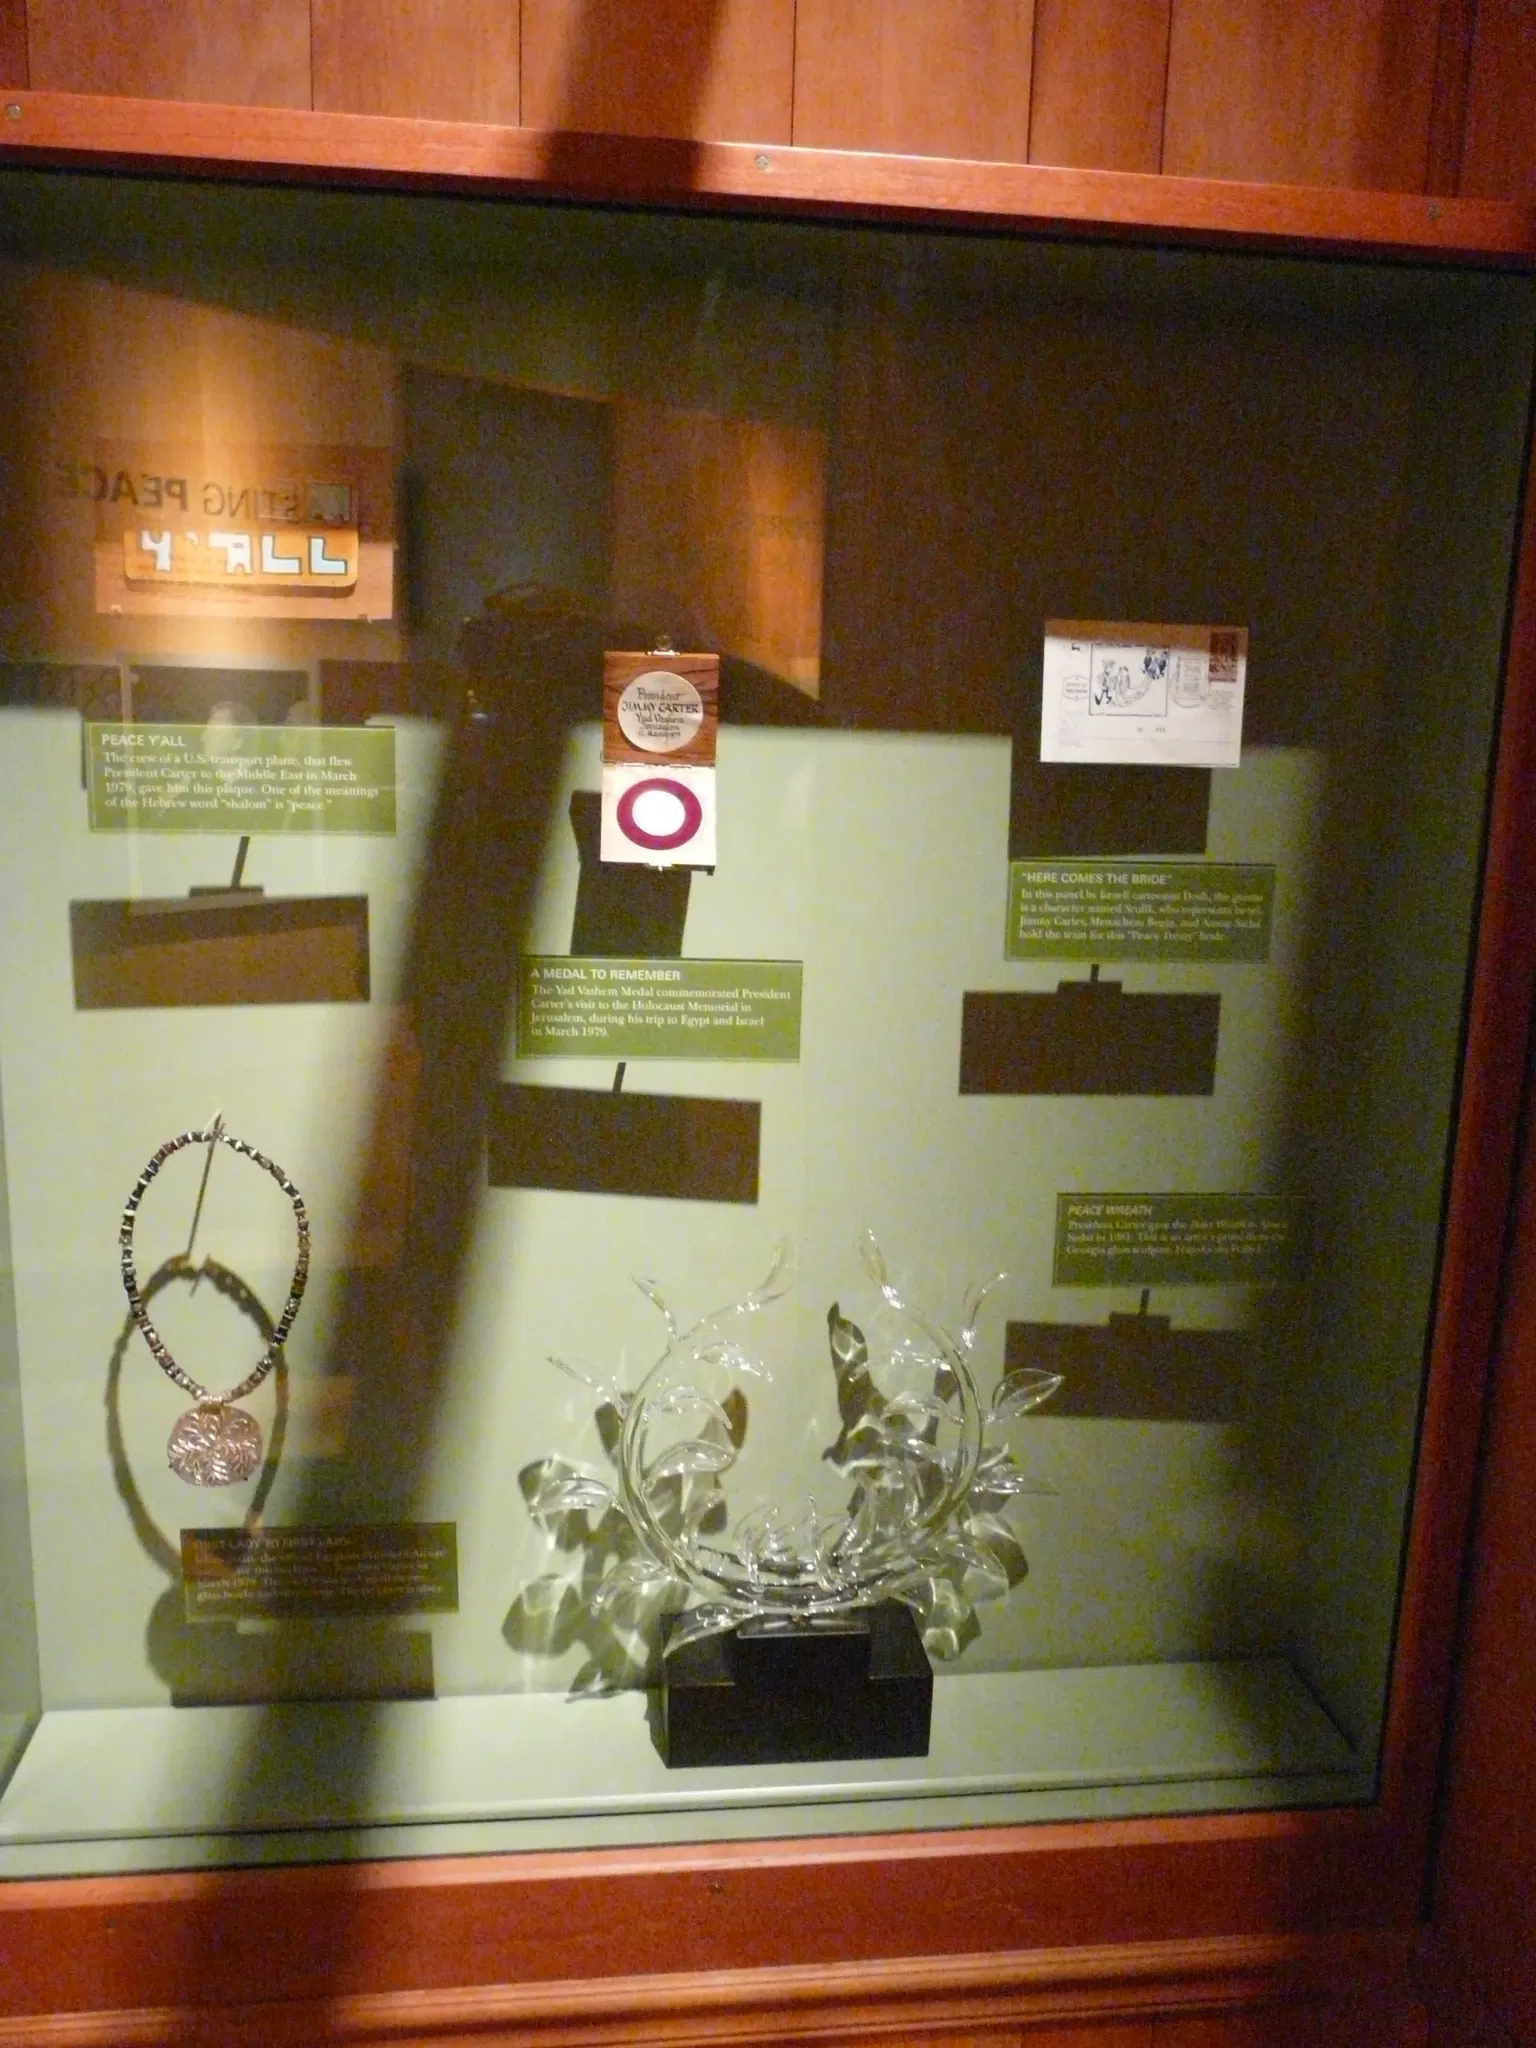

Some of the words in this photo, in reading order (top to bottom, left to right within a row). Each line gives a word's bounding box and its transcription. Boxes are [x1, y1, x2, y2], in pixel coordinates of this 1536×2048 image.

[637, 687, 684, 701] President
[621, 701, 656, 712] JIMMY
[659, 702, 699, 713] CARTER
[102, 734, 145, 746] PEACE
[148, 735, 187, 747] Y'ALL
[104, 752, 126, 763] The
[159, 752, 172, 763] of
[174, 755, 181, 764] a
[210, 754, 262, 769] transport
[304, 756, 326, 766] that
[329, 756, 353, 767] flew
[104, 767, 158, 778] President
[161, 768, 196, 779] Carter
[201, 769, 212, 779] to
[215, 768, 234, 779] the
[236, 769, 277, 780] Middle
[280, 770, 304, 781] East
[306, 770, 318, 781] in
[321, 770, 357, 781] March
[138, 784, 165, 796] gave
[167, 783, 189, 794] him
[193, 783, 213, 794] this
[261, 784, 287, 795] One
[288, 784, 302, 795] of
[304, 784, 322, 795] the
[325, 786, 379, 799] meanings
[105, 796, 117, 807] of
[119, 797, 139, 808] the
[143, 797, 187, 809] Hebrew
[189, 797, 219, 809] word
[275, 799, 284, 809] is
[1060, 873, 1104, 884] COMES
[1106, 873, 1129, 885] THE
[1021, 888, 1033, 899] In
[1035, 888, 1053, 899] this
[1055, 889, 1084, 901] panel
[1099, 889, 1130, 901] Israeli
[1213, 891, 1231, 902] the
[1020, 901, 1029, 912] is
[1038, 902, 1085, 913] character
[1087, 903, 1122, 913] named
[1159, 904, 1181, 914] who
[1018, 915, 1051, 928] Jimmy
[1054, 916, 1088, 927] Carter,
[1090, 916, 1145, 927] Menachem
[1180, 917, 1200, 928] and
[1018, 928, 1044, 939] hold
[1045, 929, 1062, 939] the
[1064, 929, 1087, 940] train
[1089, 930, 1105, 940] for
[1107, 930, 1125, 940] this
[529, 969, 540, 979] A
[543, 969, 588, 980] MEDAL
[590, 969, 607, 980] TO
[610, 969, 681, 981] REMEMBER
[532, 984, 553, 995] The
[555, 985, 575, 996] Yad
[577, 985, 618, 996] Vashem
[620, 986, 654, 997] Medal
[656, 987, 739, 999] commemorated
[742, 988, 792, 1000] President
[531, 998, 573, 1009] Carter's
[575, 999, 596, 1010] visit
[598, 1000, 610, 1010] to
[612, 1000, 629, 1010] the
[632, 1000, 685, 1012] Holocaust
[688, 1001, 738, 1012] Memorial
[741, 1002, 752, 1013] in
[530, 1011, 587, 1025] Jerusalem,
[589, 1012, 626, 1026] during
[627, 1013, 644, 1024] his
[645, 1014, 665, 1028] trip
[667, 1015, 678, 1025] to
[680, 1014, 710, 1028] Egypt
[713, 1015, 733, 1025] and
[736, 1016, 765, 1027] Israel
[531, 1026, 542, 1036] in
[545, 1026, 578, 1037] March
[582, 1026, 609, 1037] 1979.
